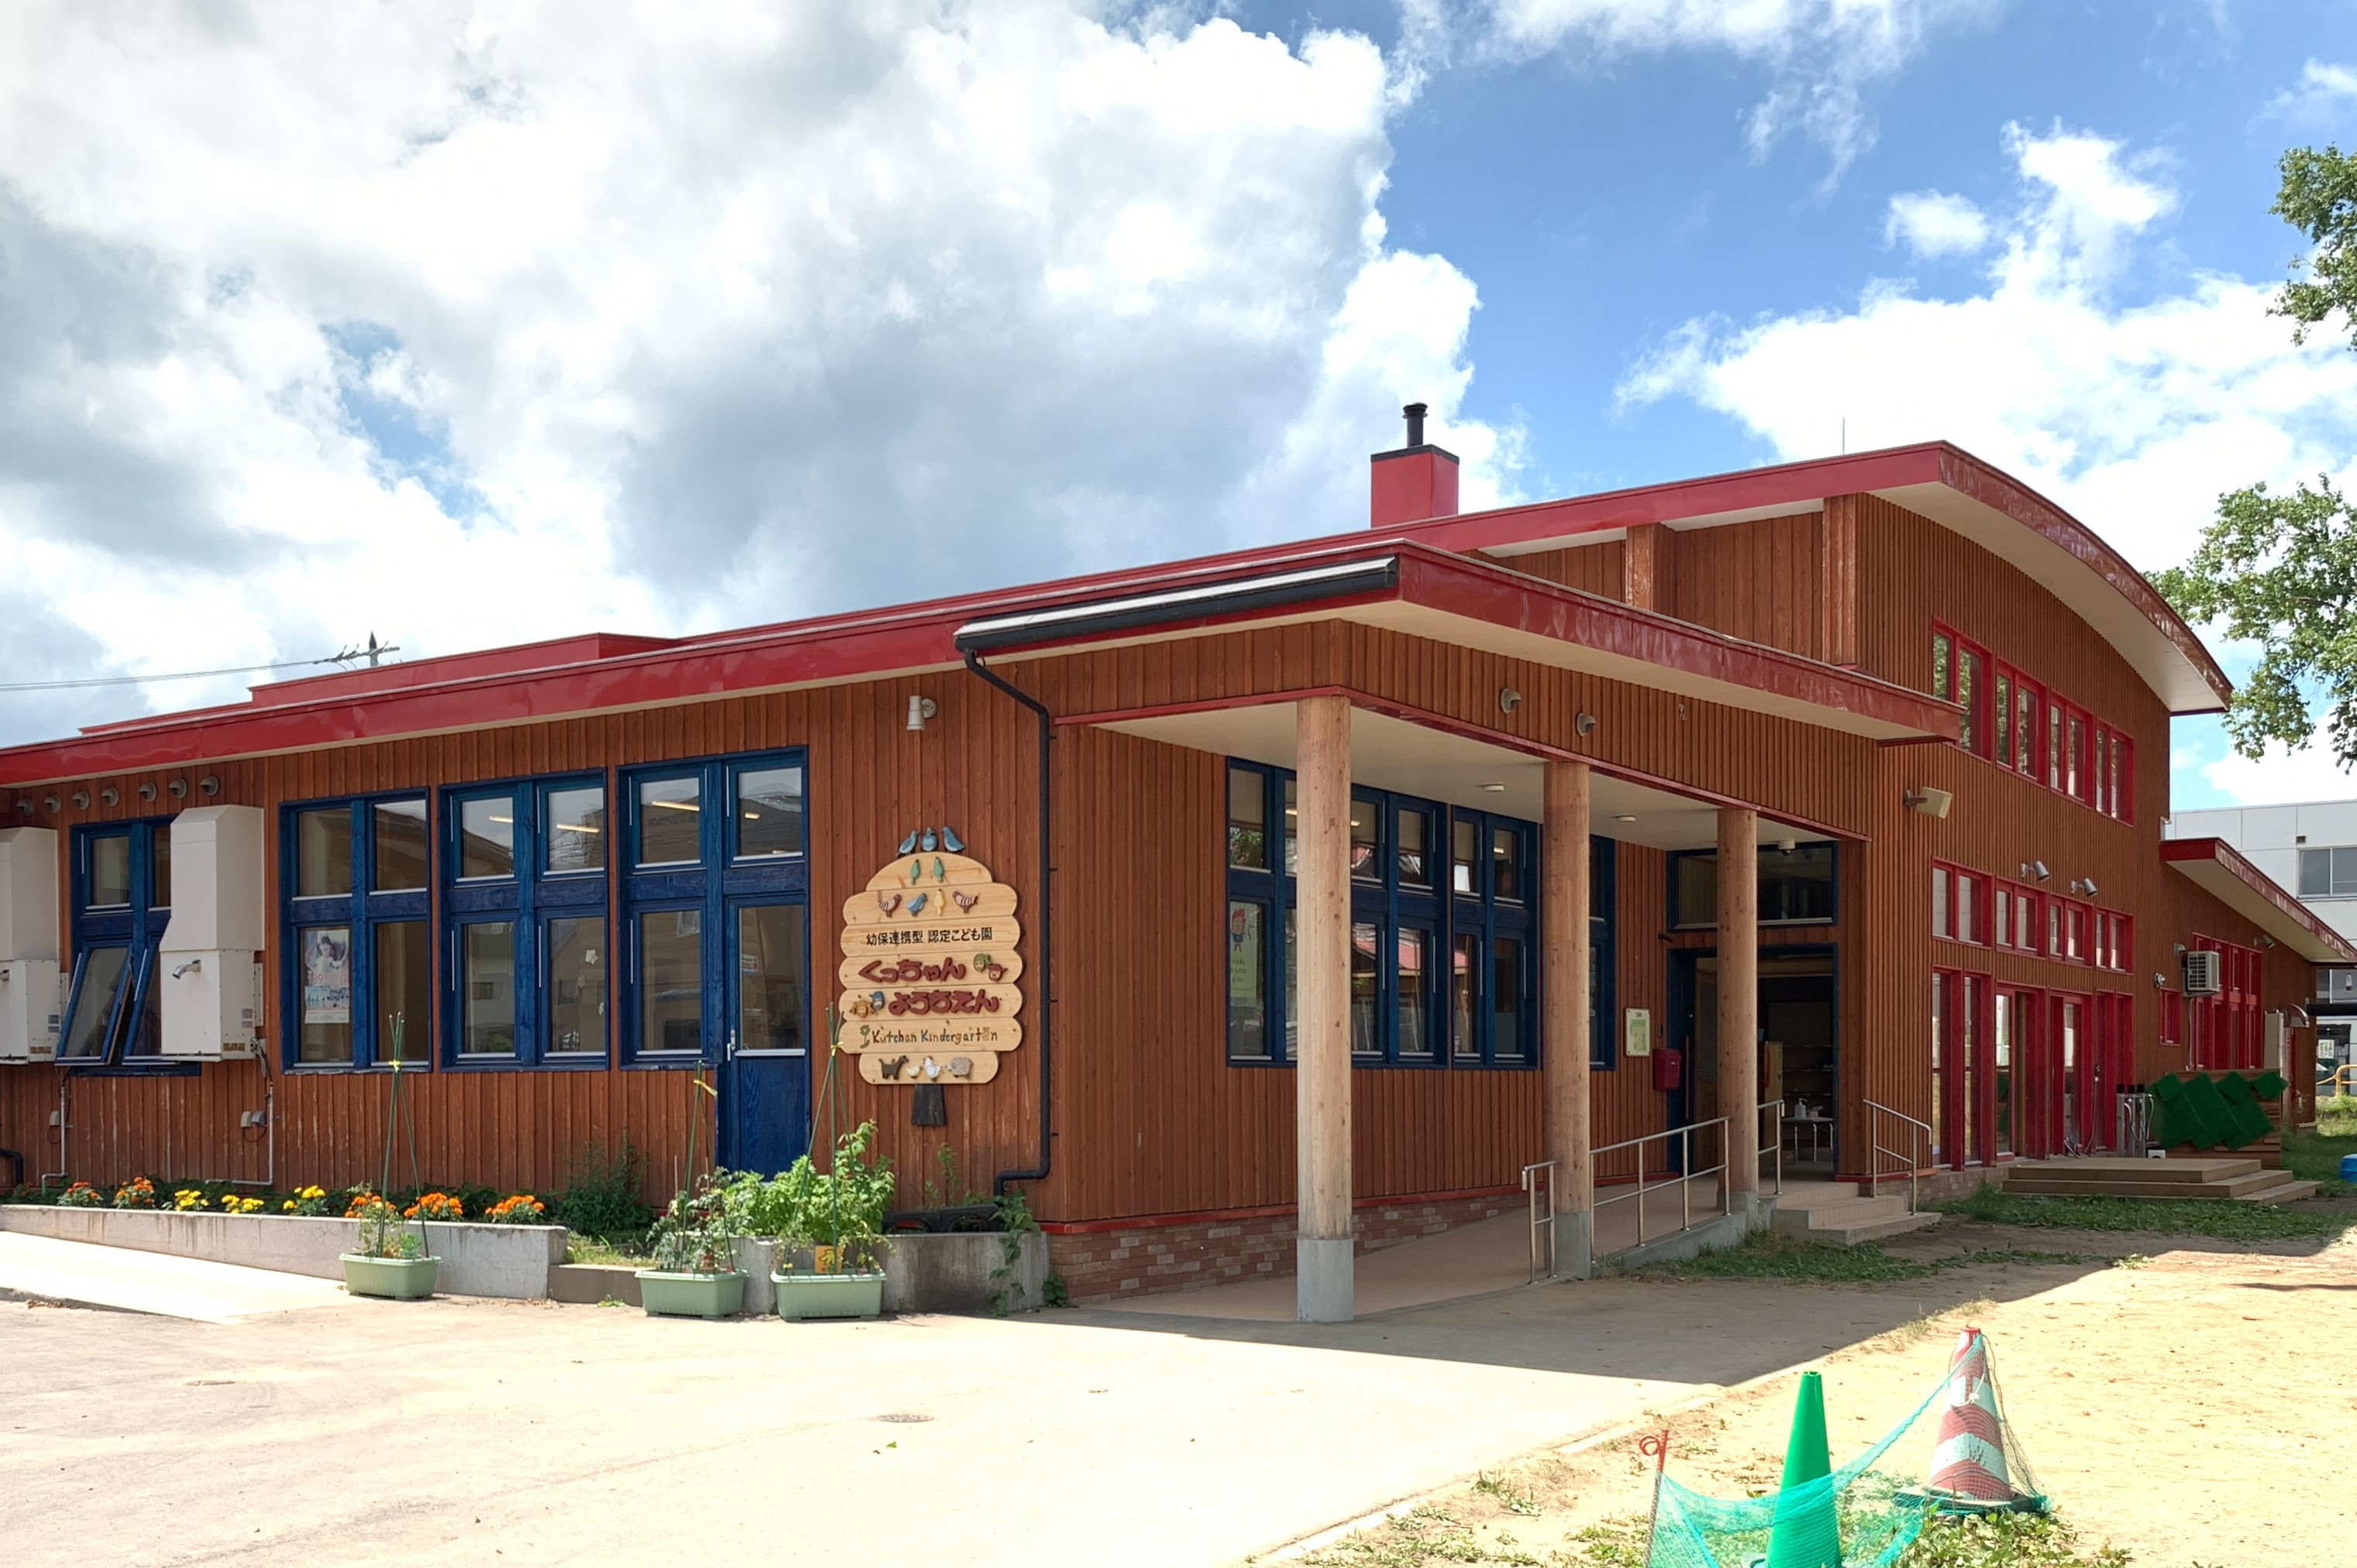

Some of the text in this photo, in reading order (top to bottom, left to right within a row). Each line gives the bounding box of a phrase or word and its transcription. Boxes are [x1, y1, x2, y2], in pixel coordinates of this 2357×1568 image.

[866, 927, 993, 947] 幼保連携型 認定こども園
[858, 957, 966, 983] くっちゃん
[888, 989, 1000, 1016] ようちえん
[872, 1027, 997, 1045] Kutchan Kindergarten
